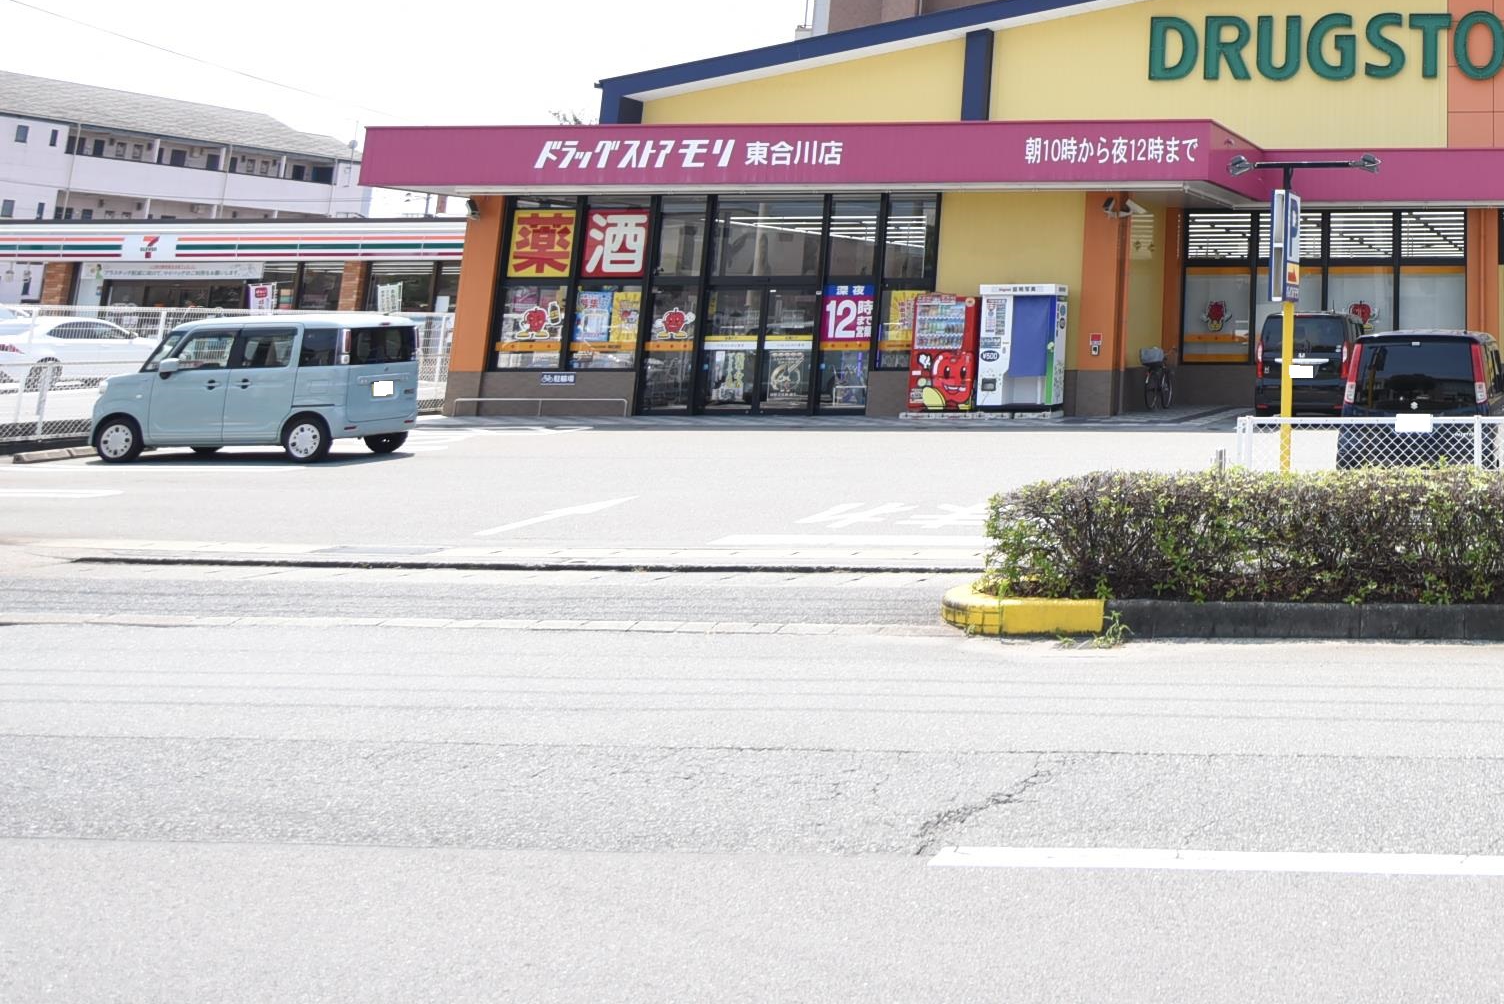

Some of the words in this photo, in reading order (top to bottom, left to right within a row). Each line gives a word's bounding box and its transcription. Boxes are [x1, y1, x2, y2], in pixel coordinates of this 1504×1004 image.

[745, 141, 843, 166] 東合川店
[1025, 136, 1199, 164] 朝10時から夜12時まで
[512, 213, 575, 274] 薬
[585, 213, 648, 273] 酒
[1289, 198, 1299, 258] P
[143, 236, 160, 258] 7
[836, 285, 865, 296] 深夜
[826, 299, 857, 339] 12
